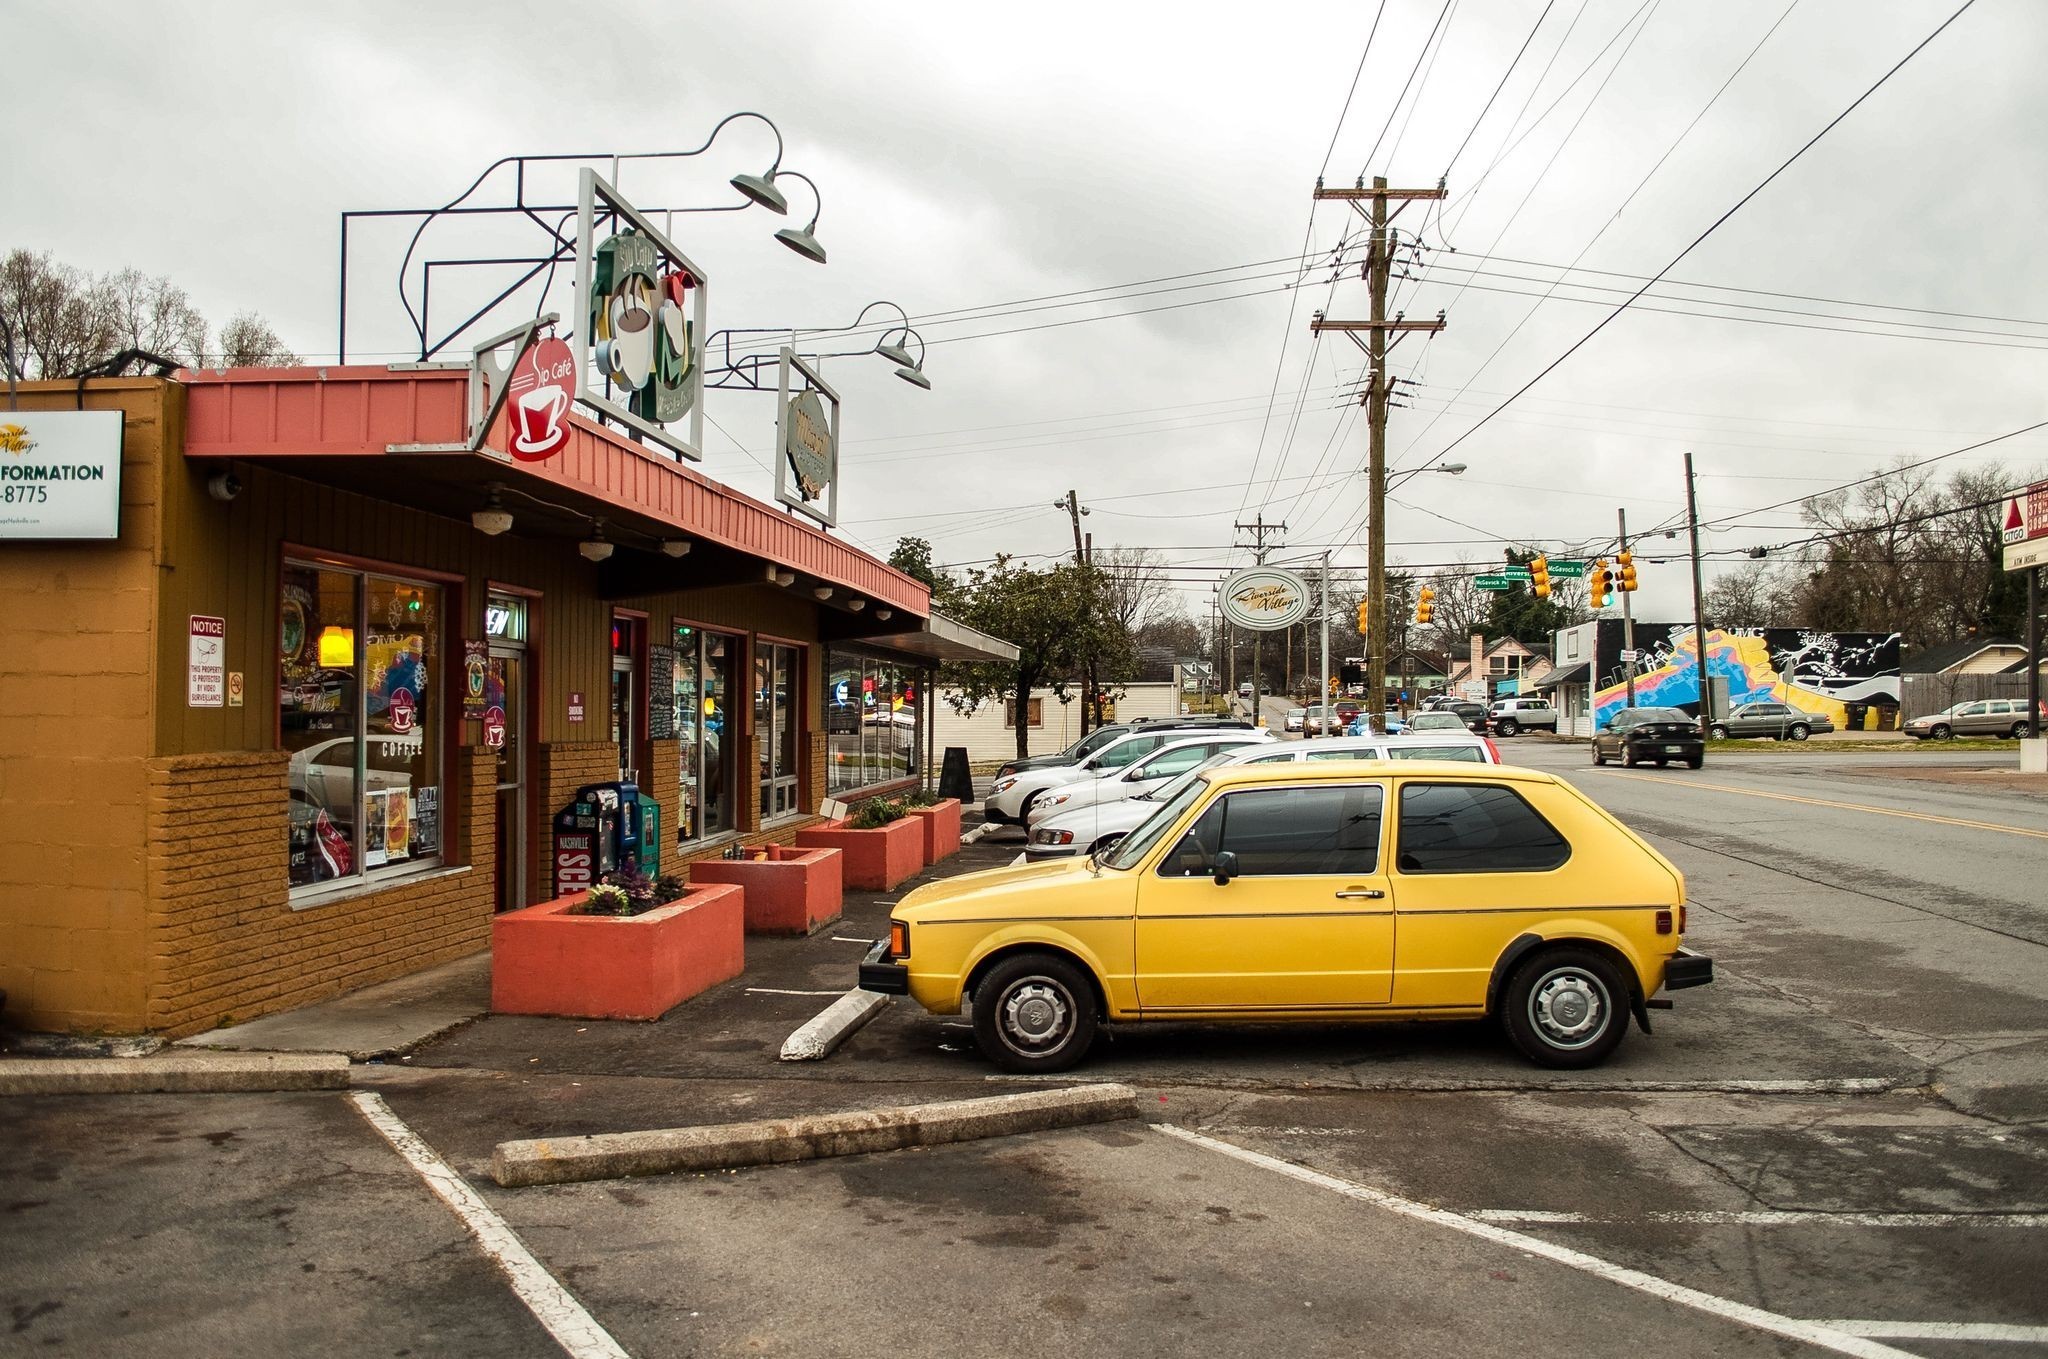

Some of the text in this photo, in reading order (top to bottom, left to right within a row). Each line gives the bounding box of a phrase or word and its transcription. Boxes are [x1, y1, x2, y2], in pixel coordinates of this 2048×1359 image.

[552, 357, 572, 379] Café
[2003, 528, 2024, 542] CITGO
[1230, 584, 1287, 603] Riverside
[1257, 595, 1299, 612] Village
[192, 620, 223, 634] NOTICE
[486, 607, 510, 635] EN
[1728, 627, 1765, 638] OMG
[191, 665, 222, 674] THIS PROPERTY
[192, 674, 221, 683] IS PROTECTED
[197, 684, 216, 692] BY VIDEO
[191, 693, 221, 703] SURVEILLANCE
[382, 741, 422, 757] COFFEE
[559, 836, 589, 850] NASHVILLE
[558, 853, 591, 900] SCE
